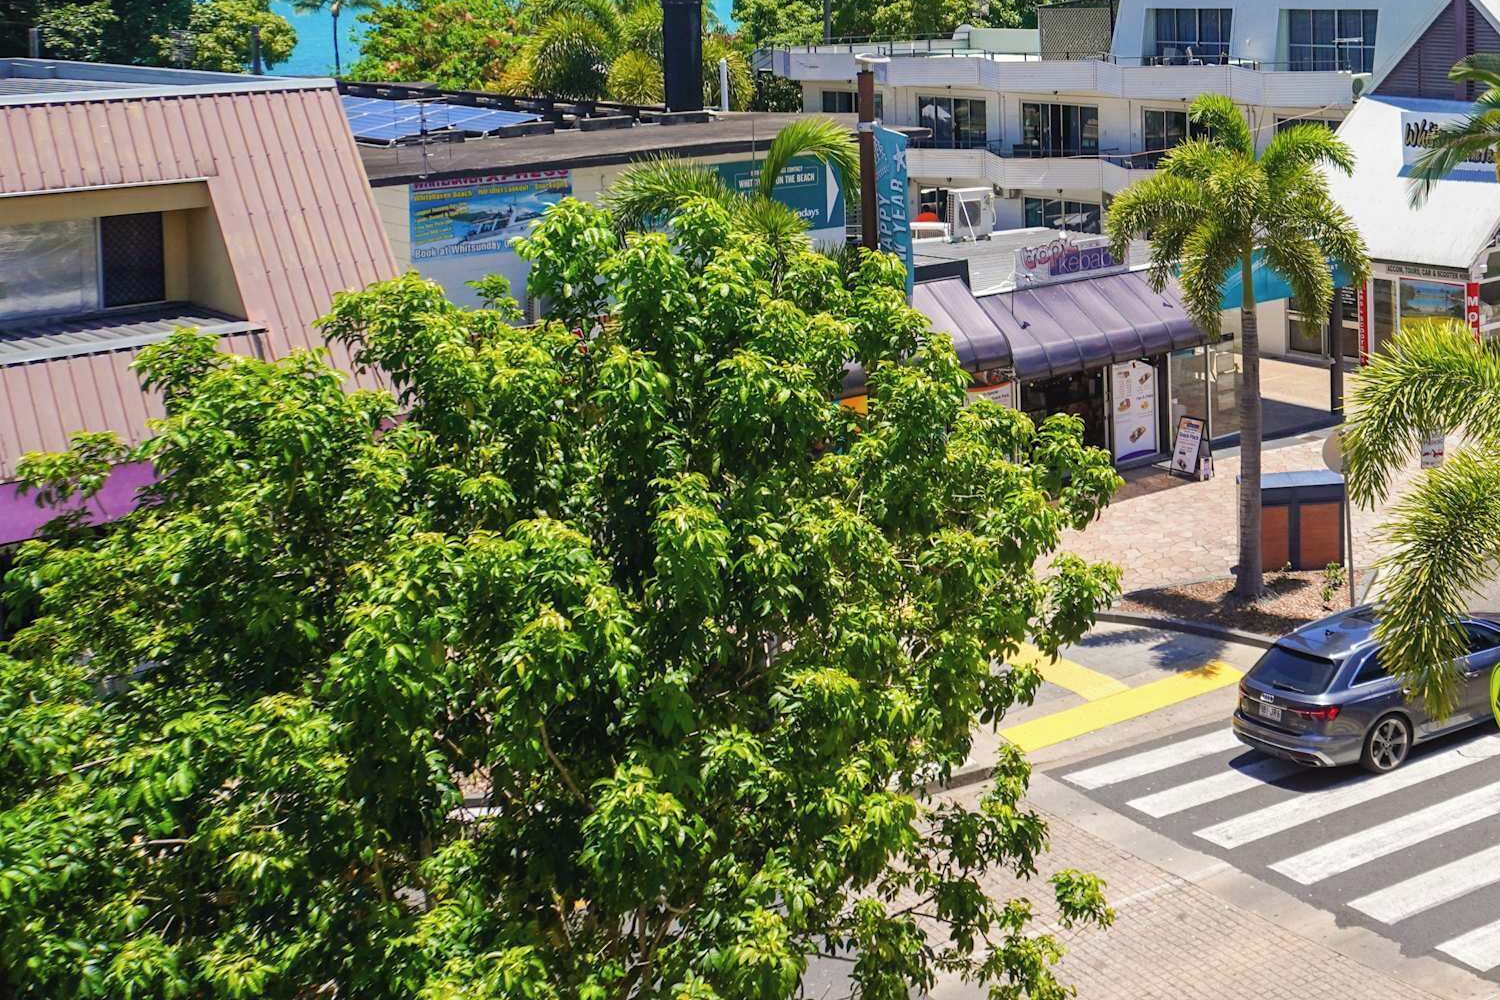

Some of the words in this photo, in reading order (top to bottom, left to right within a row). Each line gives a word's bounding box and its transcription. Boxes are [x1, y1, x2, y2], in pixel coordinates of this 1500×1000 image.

[785, 175, 795, 184] THE
[797, 173, 815, 182] BEACH
[890, 178, 906, 233] YEAR
[878, 193, 893, 252] APPY
[415, 247, 435, 258] Book
[451, 239, 501, 255] Whitsunday
[1059, 248, 1116, 274] kebab
